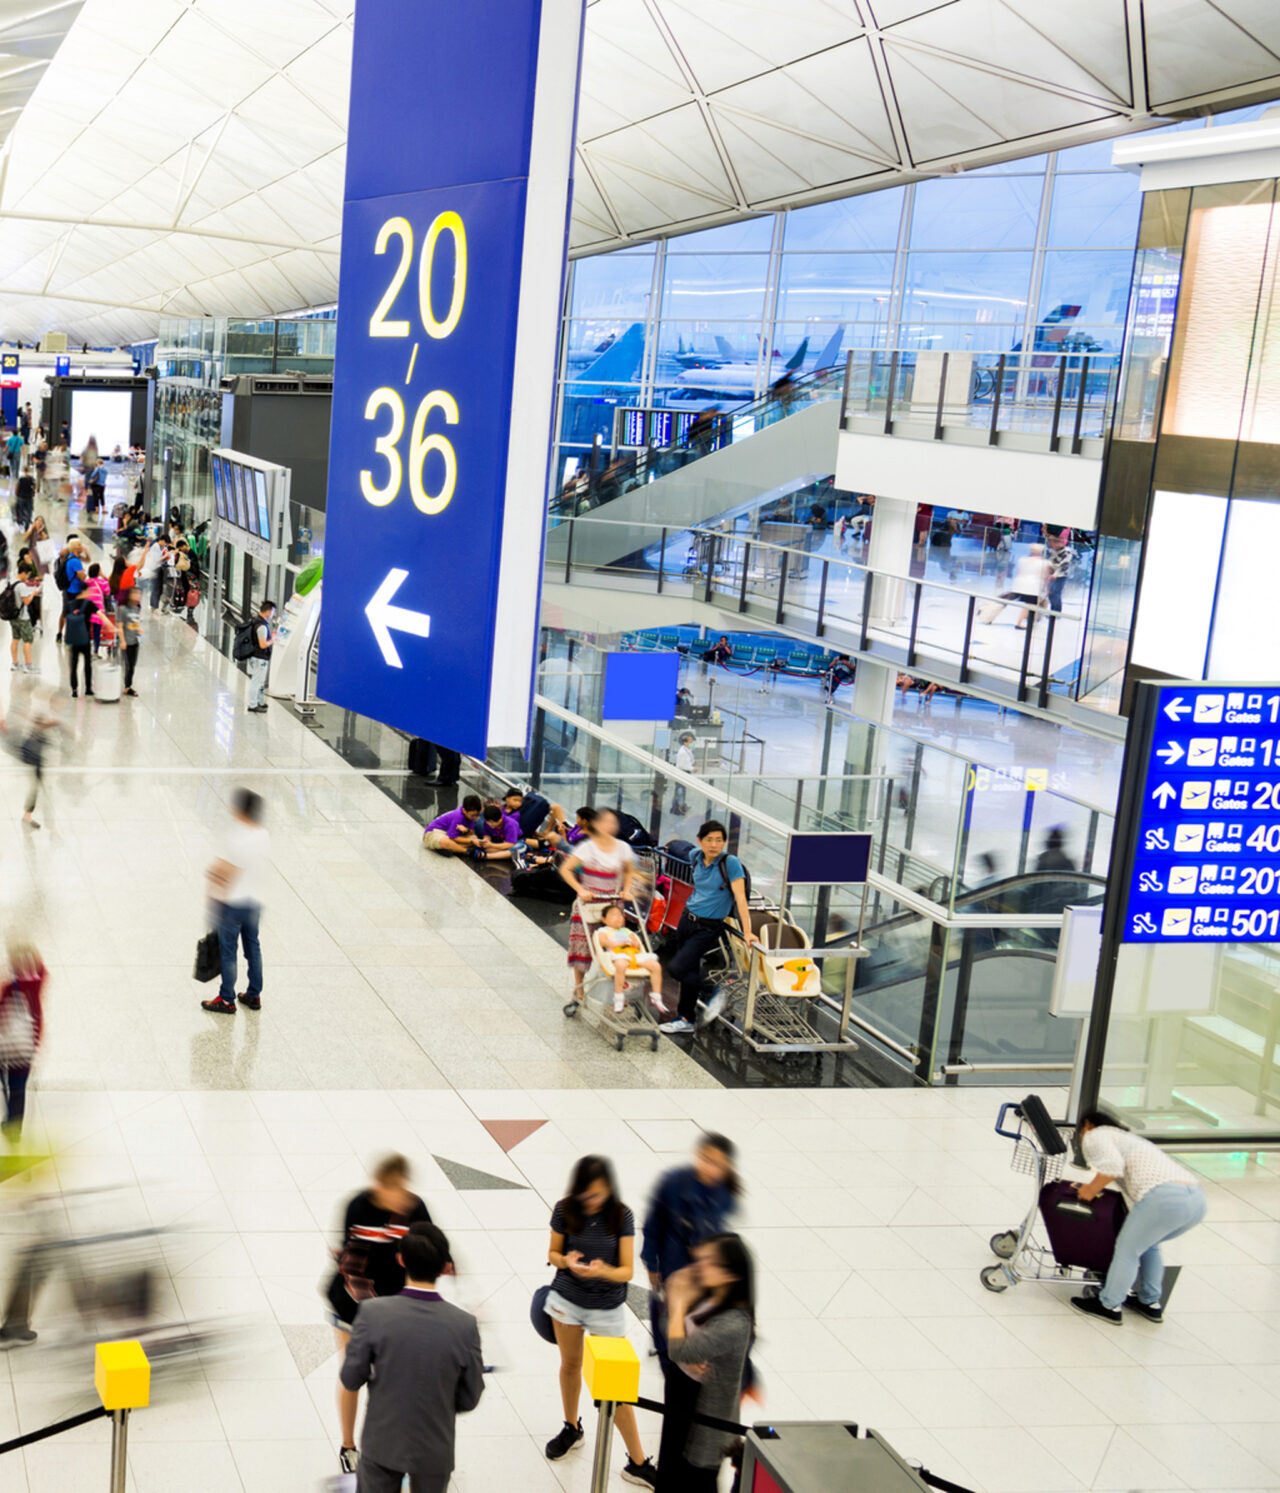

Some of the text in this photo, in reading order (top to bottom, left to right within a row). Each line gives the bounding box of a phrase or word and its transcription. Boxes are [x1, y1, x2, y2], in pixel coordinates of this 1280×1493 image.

[368, 211, 467, 340] 20
[4, 356, 17, 367] 20
[359, 386, 460, 515] 36
[1246, 824, 1280, 852] 40
[1231, 909, 1280, 936] 501
